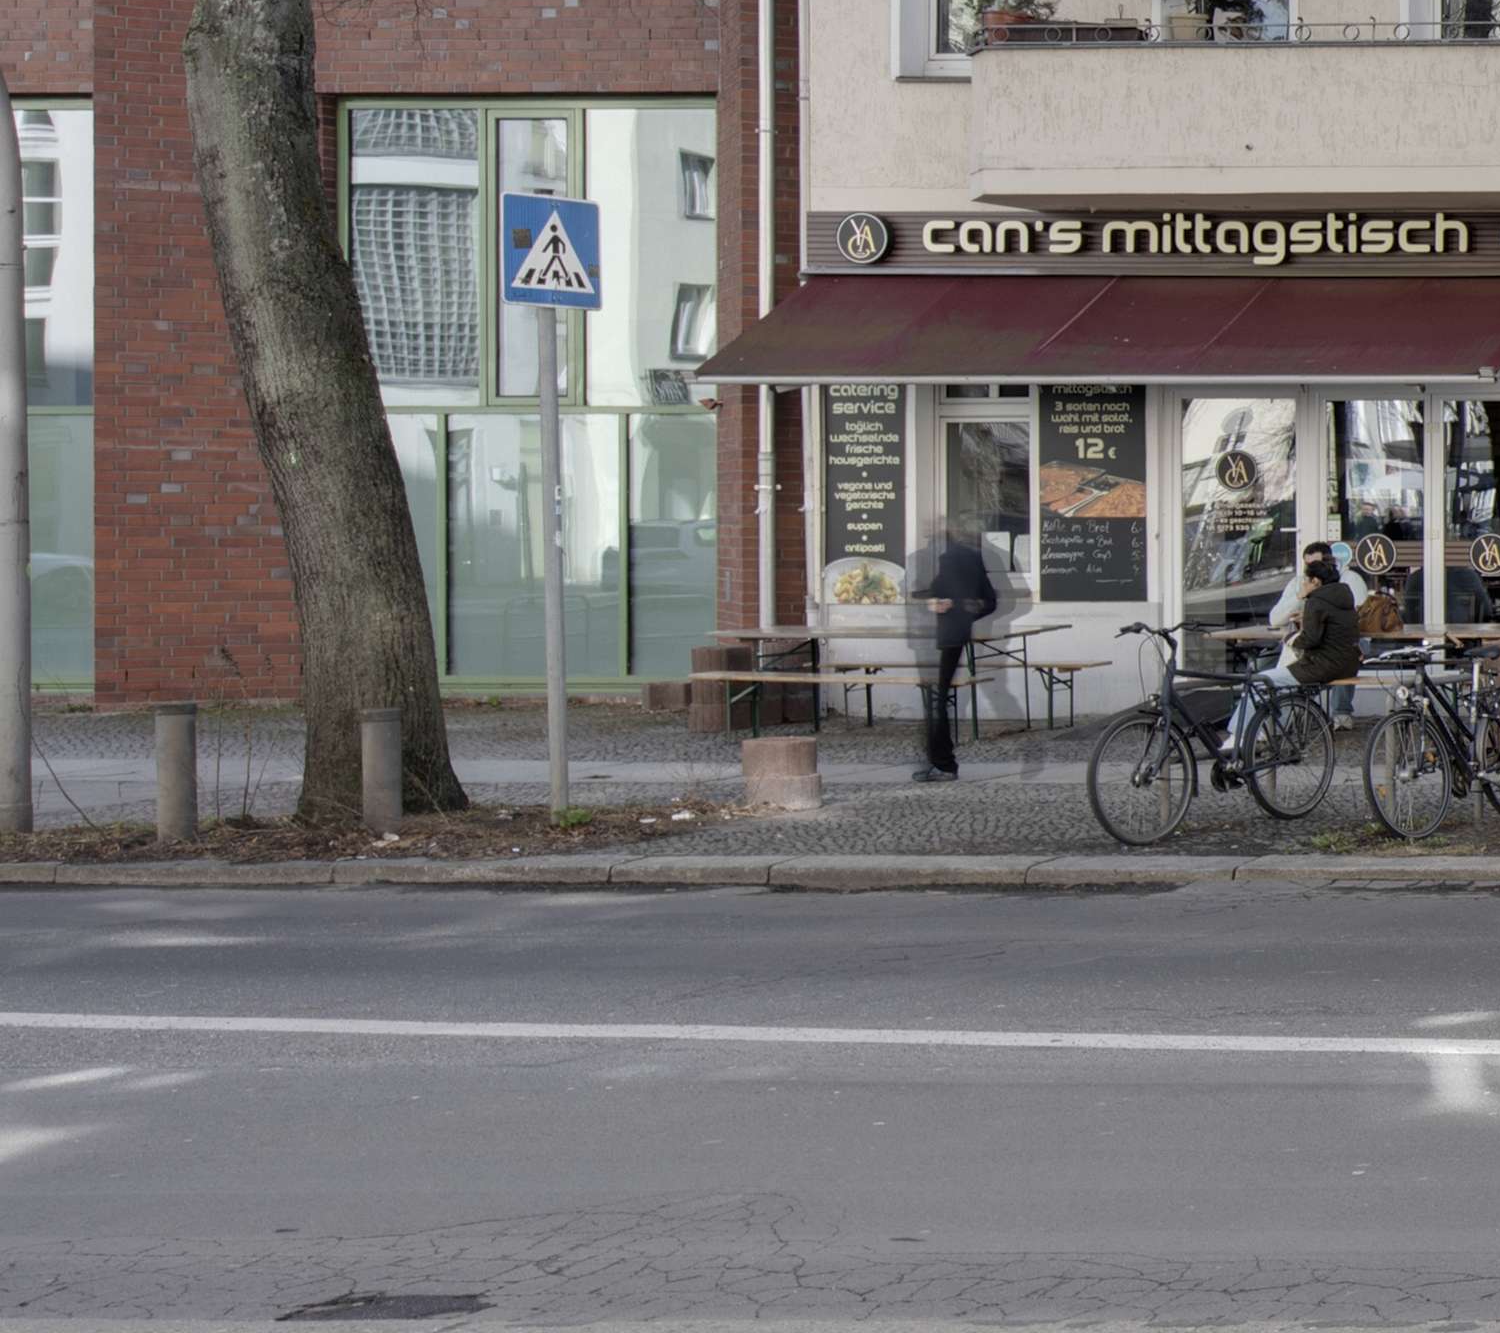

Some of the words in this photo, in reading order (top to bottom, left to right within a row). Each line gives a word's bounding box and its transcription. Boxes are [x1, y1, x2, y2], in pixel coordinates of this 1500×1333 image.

[922, 219, 1083, 255] can's
[1102, 212, 1469, 266] mittagstisch
[829, 384, 899, 400] catering
[832, 399, 896, 414] service
[1054, 401, 1064, 411] 3
[1066, 401, 1100, 411] sorten
[1051, 413, 1080, 423] wahl
[1081, 413, 1099, 422] mit
[1080, 423, 1101, 433] und
[1103, 423, 1126, 433] brot
[845, 444, 883, 454] frische
[1075, 437, 1105, 459] 12
[1107, 446, 1117, 459] €
[829, 455, 900, 467] hausgerichte
[874, 482, 893, 490] und
[846, 522, 883, 531] suppen
